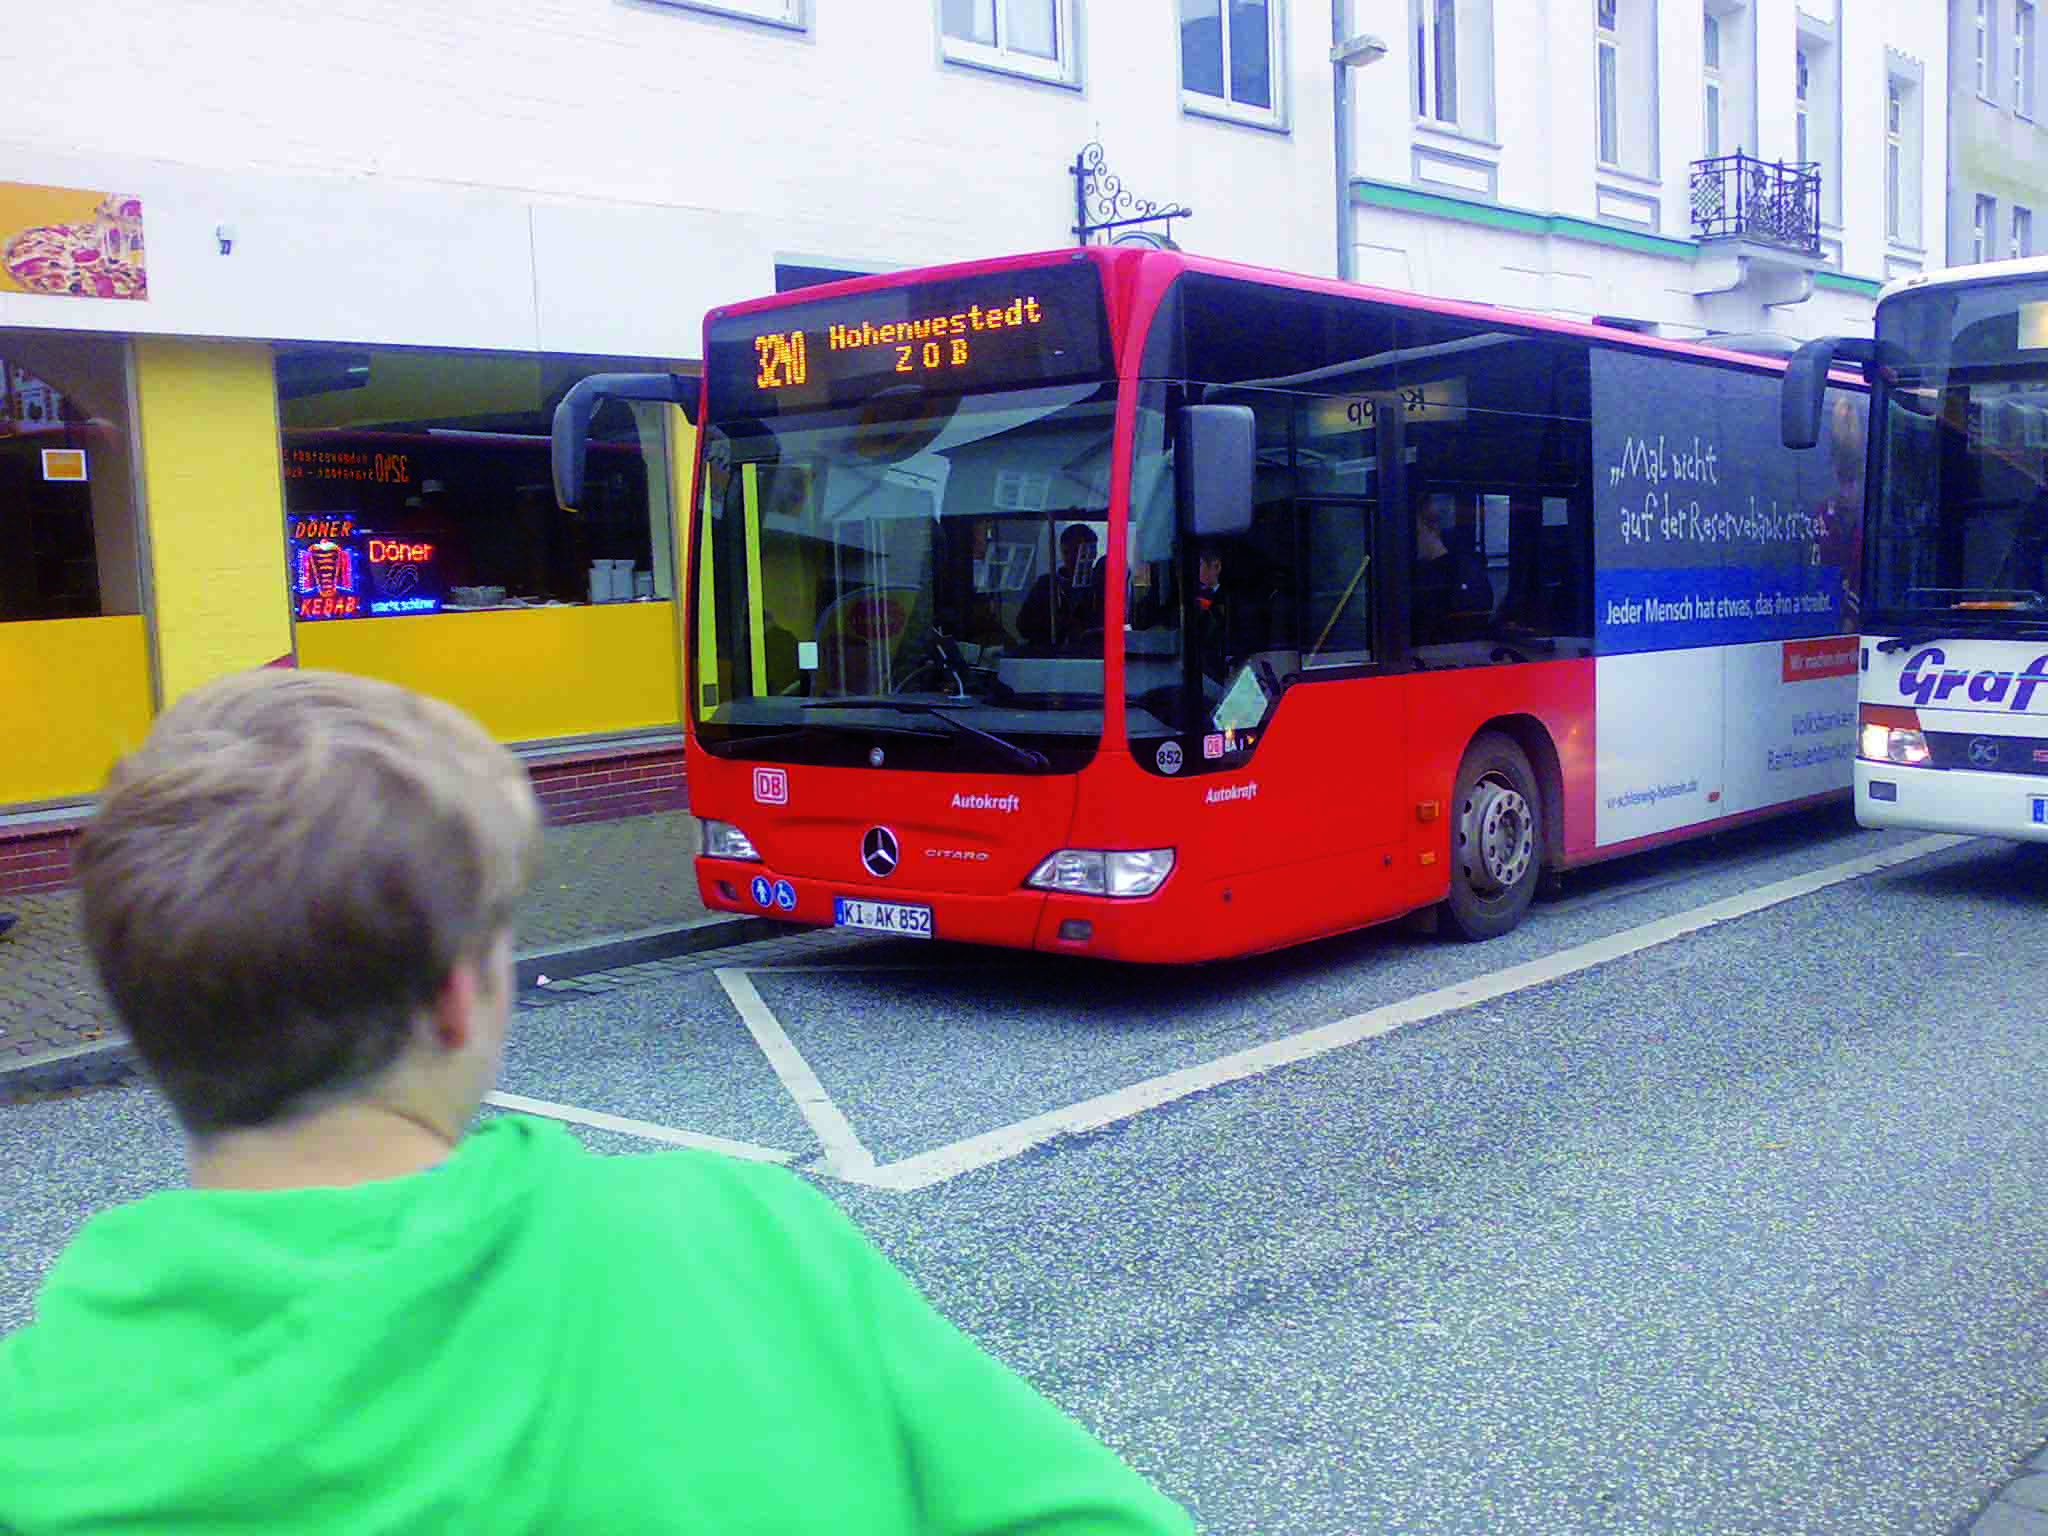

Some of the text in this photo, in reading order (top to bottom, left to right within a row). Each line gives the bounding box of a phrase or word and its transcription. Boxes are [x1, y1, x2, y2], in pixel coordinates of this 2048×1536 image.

[755, 331, 807, 389] 3240
[1671, 436, 1718, 485] nicht
[295, 519, 353, 539] DÖNER
[1620, 493, 1659, 545] auf
[1660, 492, 1688, 542] der
[368, 539, 433, 563] Döner
[300, 596, 357, 616] KEBAB
[1606, 597, 1643, 626] Jeder
[1644, 594, 1692, 624] Mensch
[1695, 594, 1716, 620] hat
[1755, 592, 1774, 616] das
[1158, 749, 1182, 765] 852
[758, 773, 784, 798] DB
[1204, 781, 1258, 804] Autokraft
[951, 792, 1020, 813] Autokraft
[924, 849, 990, 862] CITARO
[844, 902, 930, 932] KI AK 852
